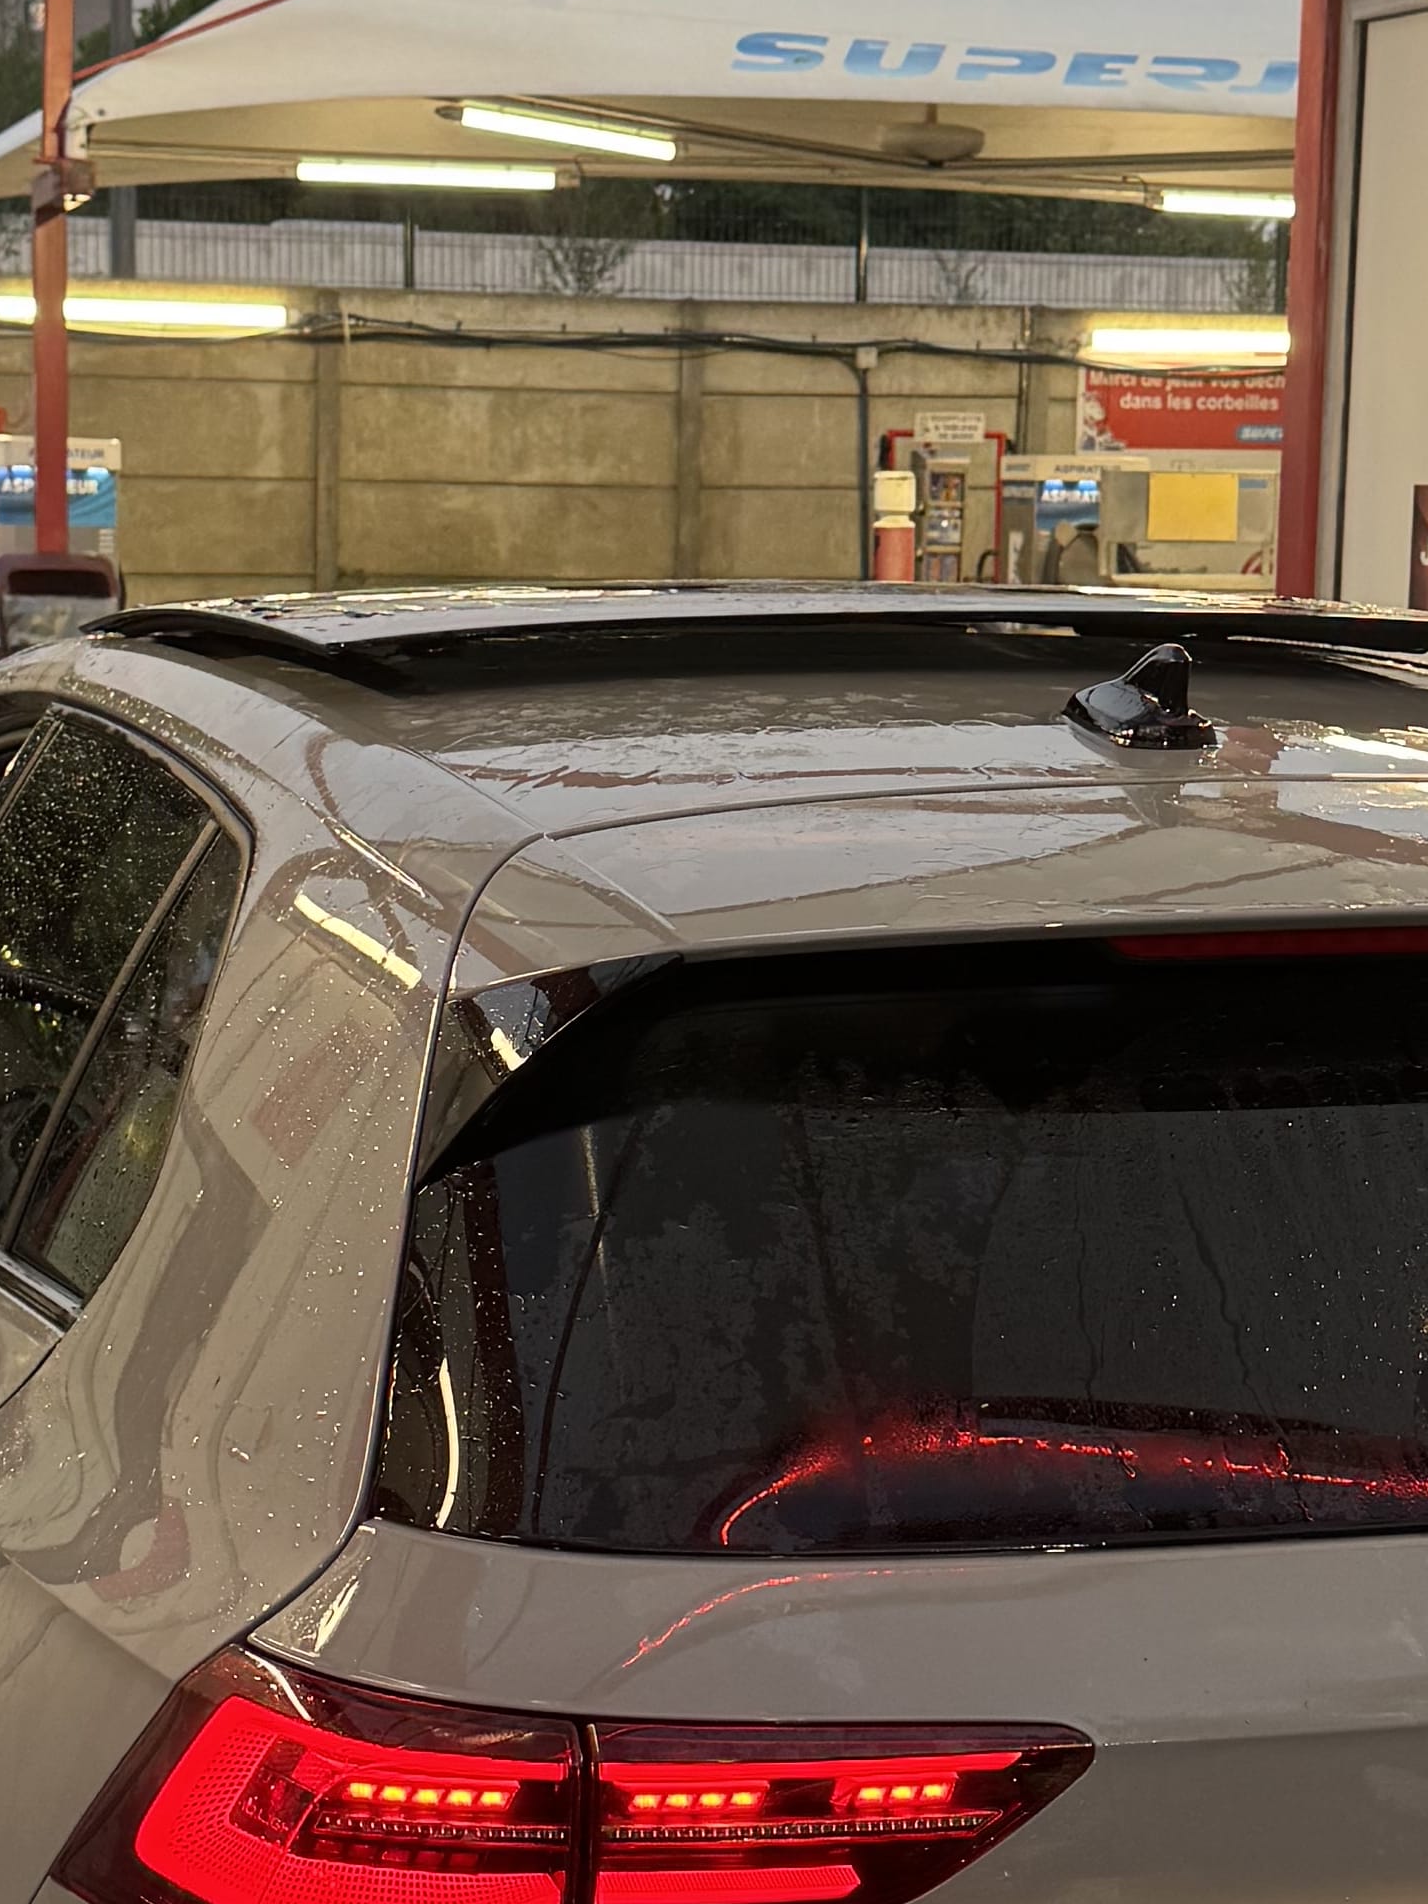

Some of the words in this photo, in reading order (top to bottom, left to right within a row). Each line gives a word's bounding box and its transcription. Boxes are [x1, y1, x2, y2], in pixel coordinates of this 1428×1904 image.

[1120, 393, 1162, 409] dans
[1167, 394, 1193, 410] les
[1196, 394, 1280, 411] corbeilles
